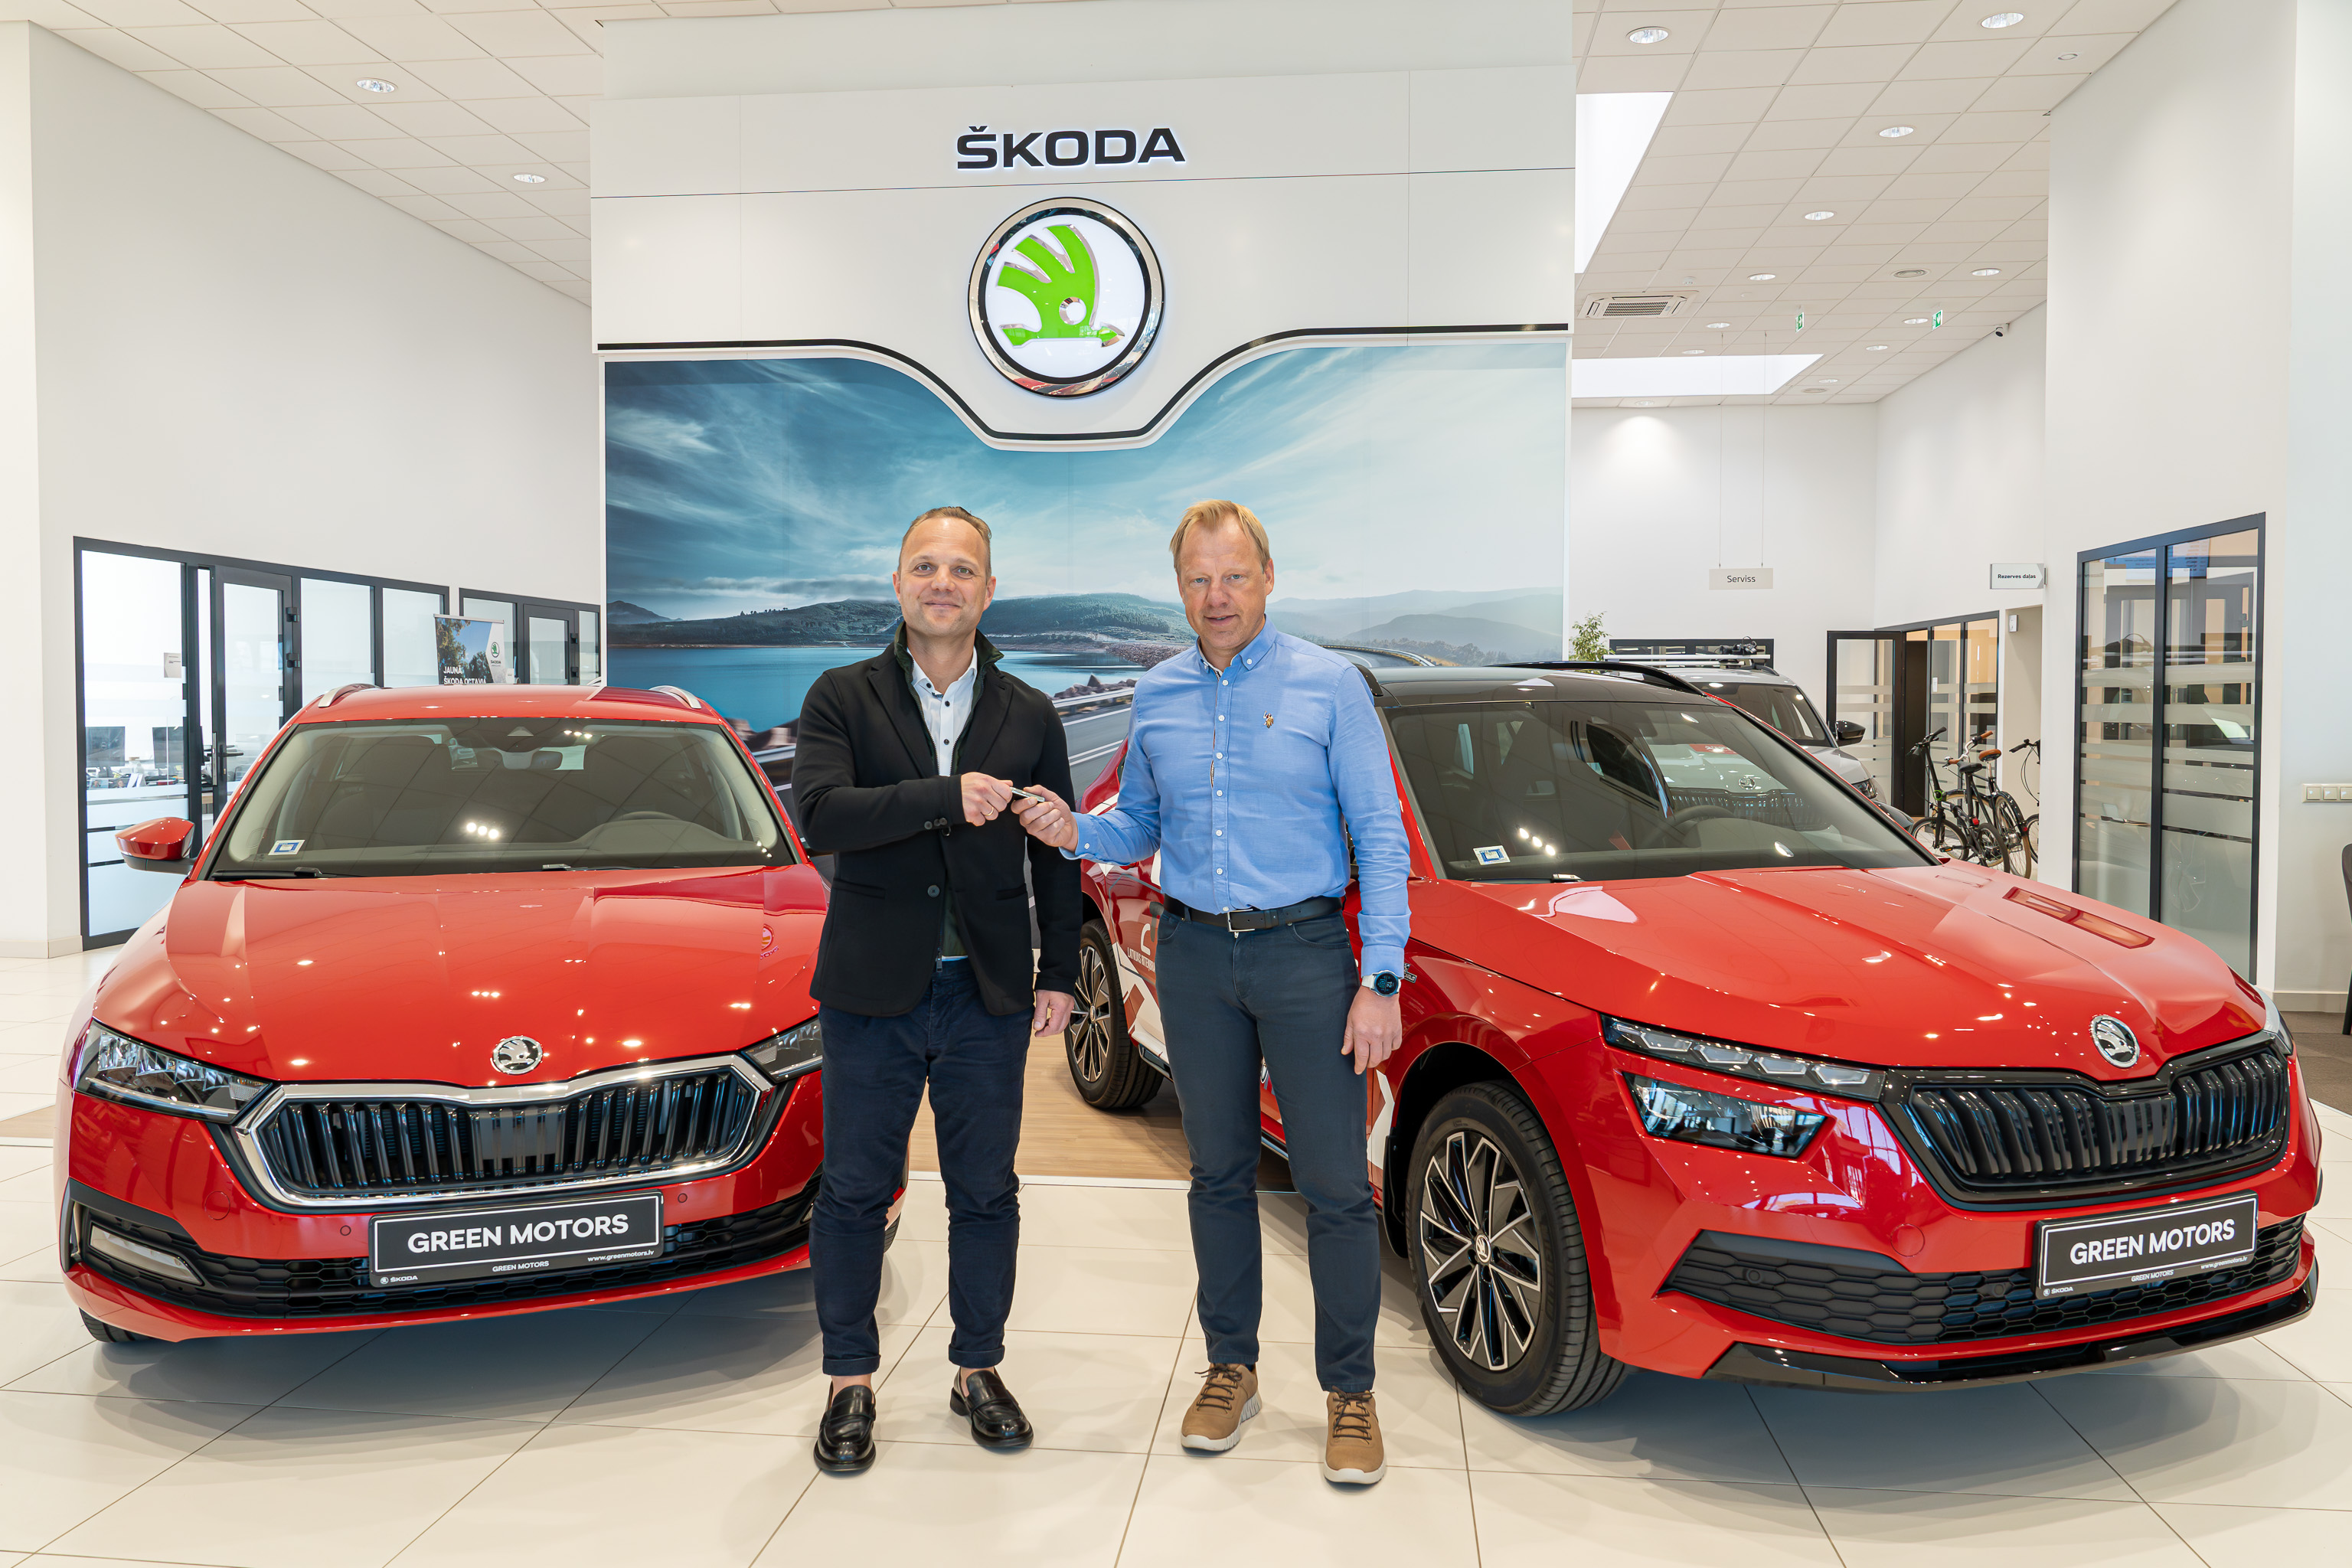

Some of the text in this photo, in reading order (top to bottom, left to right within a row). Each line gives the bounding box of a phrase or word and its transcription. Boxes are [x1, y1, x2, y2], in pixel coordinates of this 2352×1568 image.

[956, 125, 1186, 169] ŠKODA
[443, 665, 462, 674] JAUNĀ
[443, 675, 463, 684] ŠKODA
[407, 1214, 629, 1253] GREEN MOTORS
[2069, 1218, 2236, 1265] GREEN MOTORS
[587, 1250, 655, 1262] www.greenmotors.lv
[492, 1260, 549, 1272] GREEN MOTORS
[2200, 1256, 2248, 1269] www.greenmotors.lv
[2131, 1269, 2174, 1282] GREEN MOTORS
[2051, 1286, 2073, 1295] ŠKODA
